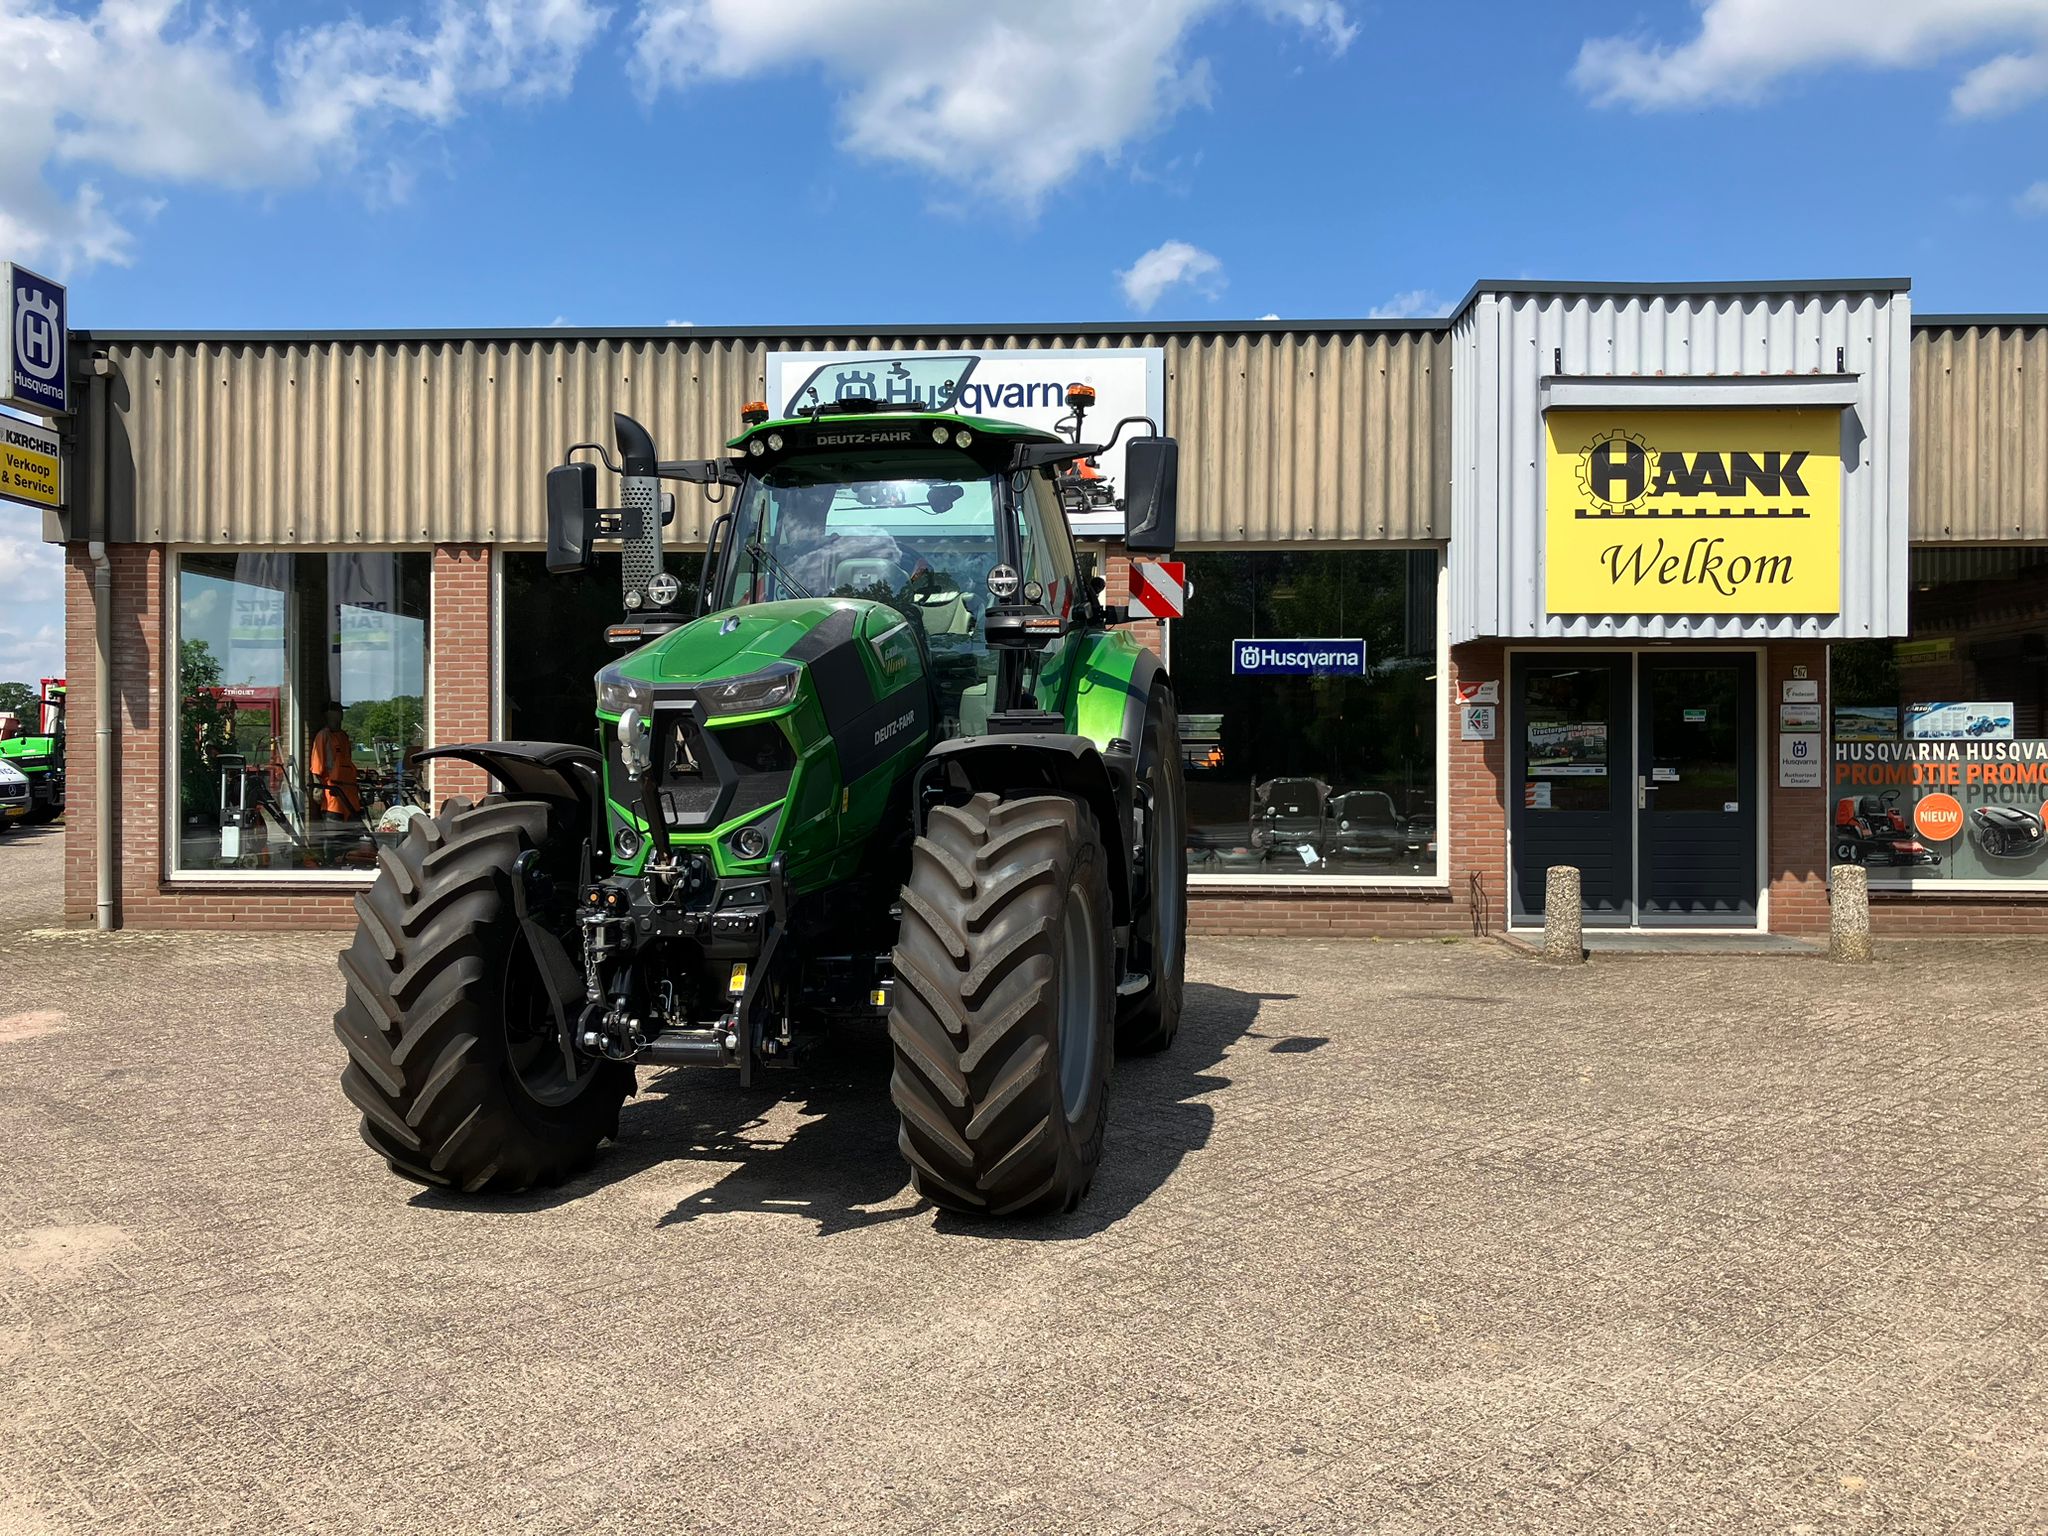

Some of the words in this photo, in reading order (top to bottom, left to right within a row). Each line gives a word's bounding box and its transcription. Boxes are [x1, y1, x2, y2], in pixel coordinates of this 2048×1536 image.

[14, 370, 64, 400] Husqvarna
[6, 429, 58, 457] KÄRCHER
[816, 431, 912, 446] DEUTZ-FAHR
[6, 453, 51, 479] Verkoop
[1590, 440, 1810, 503] HAANK
[1, 470, 10, 484] &
[14, 473, 55, 495] Service
[1600, 537, 1794, 596] Welkom
[1261, 649, 1359, 669] Husqvarna
[874, 709, 915, 746] DEUTZ-FAHR
[1782, 758, 1818, 766] Husqvarna
[1836, 743, 1960, 762] HUSQVARNA
[1966, 743, 2048, 762] HUSQVA
[1835, 763, 1961, 785] PROMOTIE
[1967, 763, 2048, 785] PROMO
[1919, 811, 1958, 823] NIEUW
